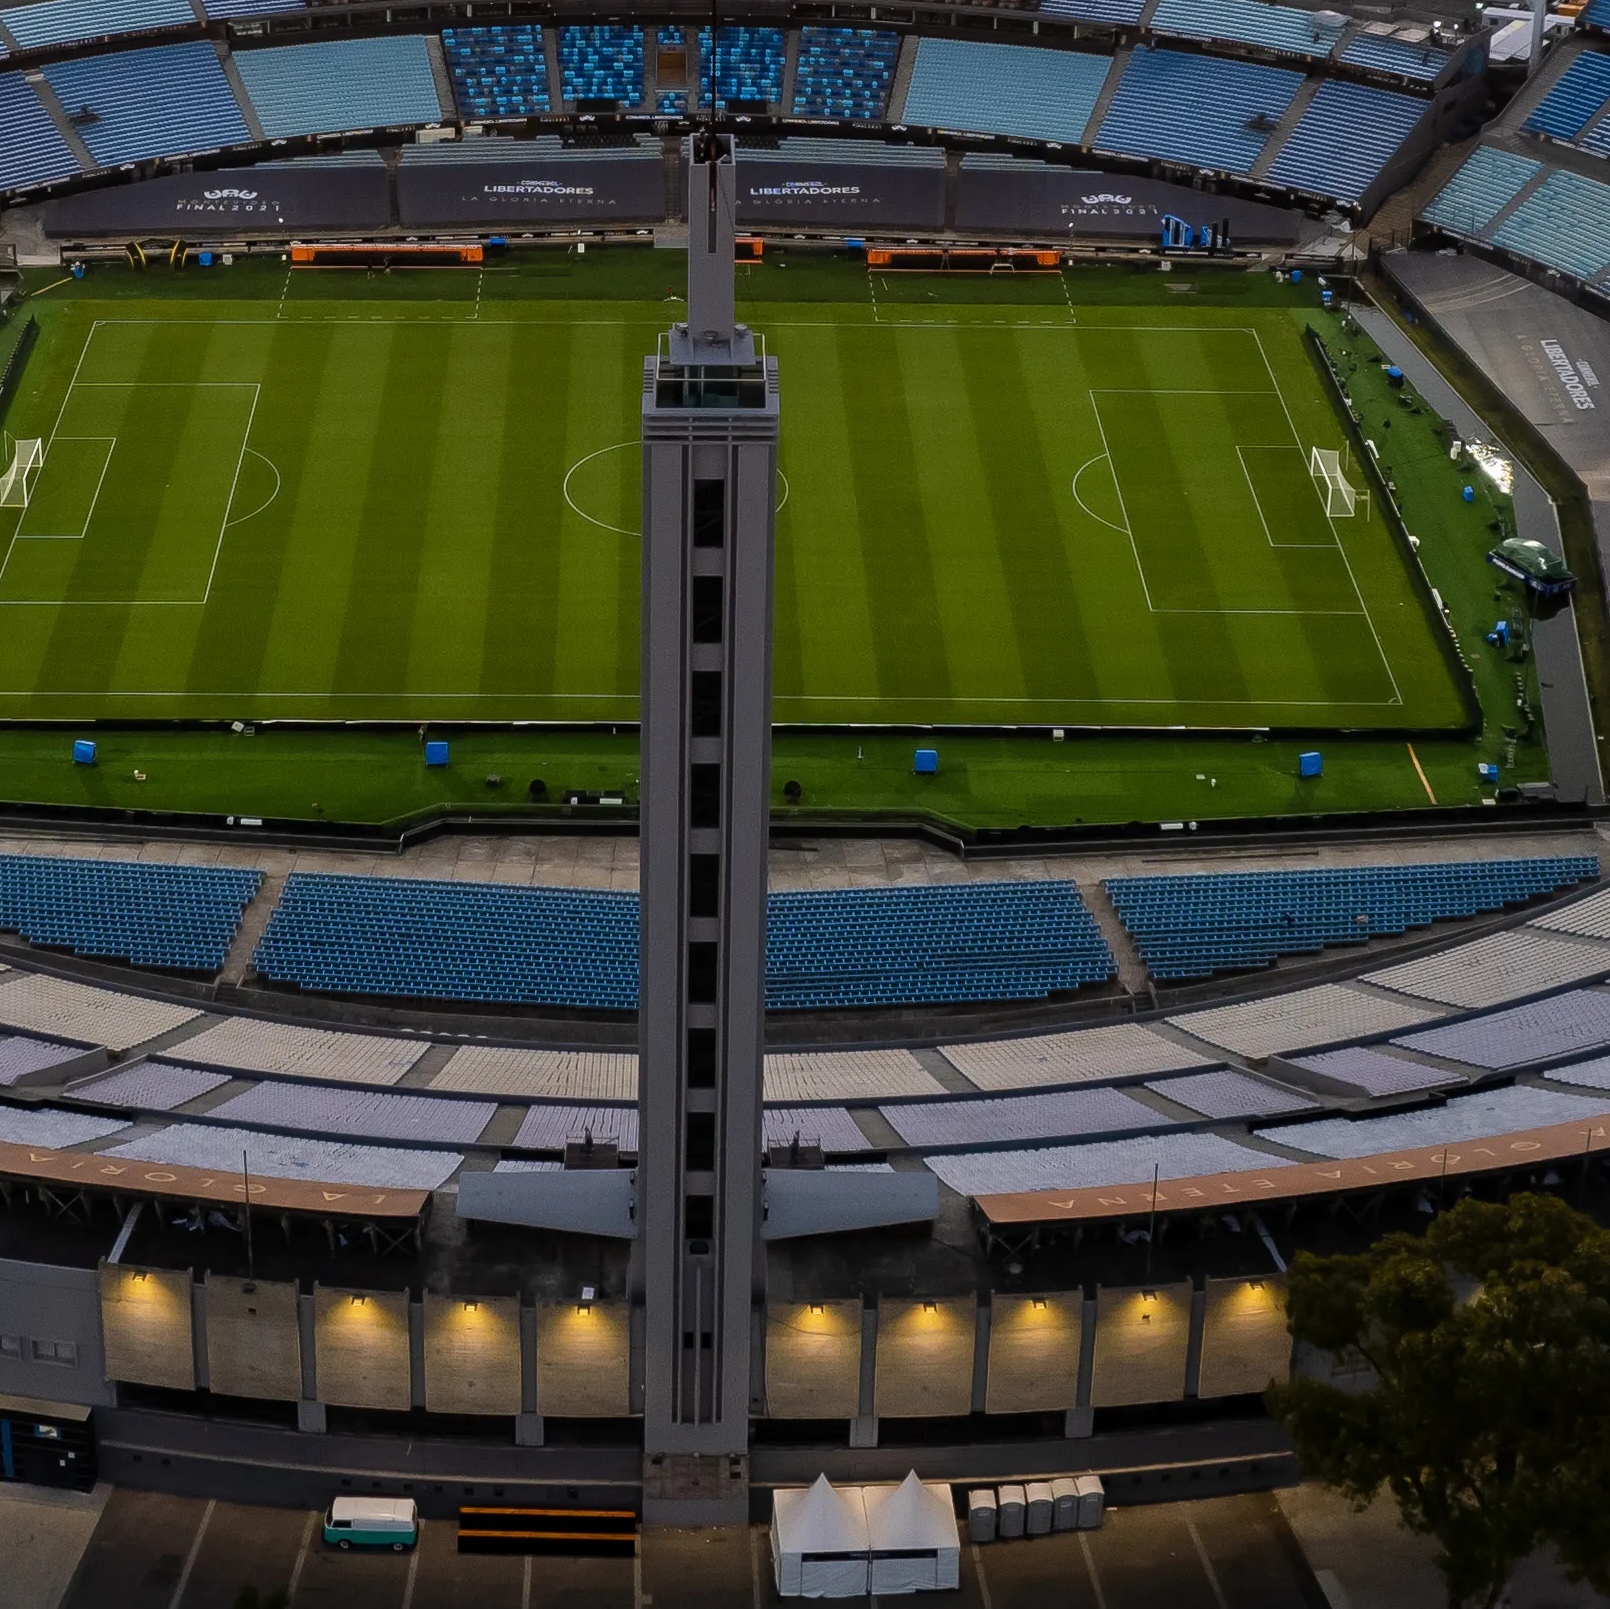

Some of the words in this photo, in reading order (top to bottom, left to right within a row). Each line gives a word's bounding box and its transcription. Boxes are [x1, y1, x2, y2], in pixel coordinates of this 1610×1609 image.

[484, 185, 594, 195] LIBERTADORES
[750, 187, 860, 196] LIBERTADORES
[1540, 339, 1594, 411] LIBERTADORES
[1577, 1126, 1609, 1138] A
[27, 1151, 268, 1195] GLORIA
[320, 1190, 387, 1206] LA
[1047, 1178, 1280, 1210] ETERNA
